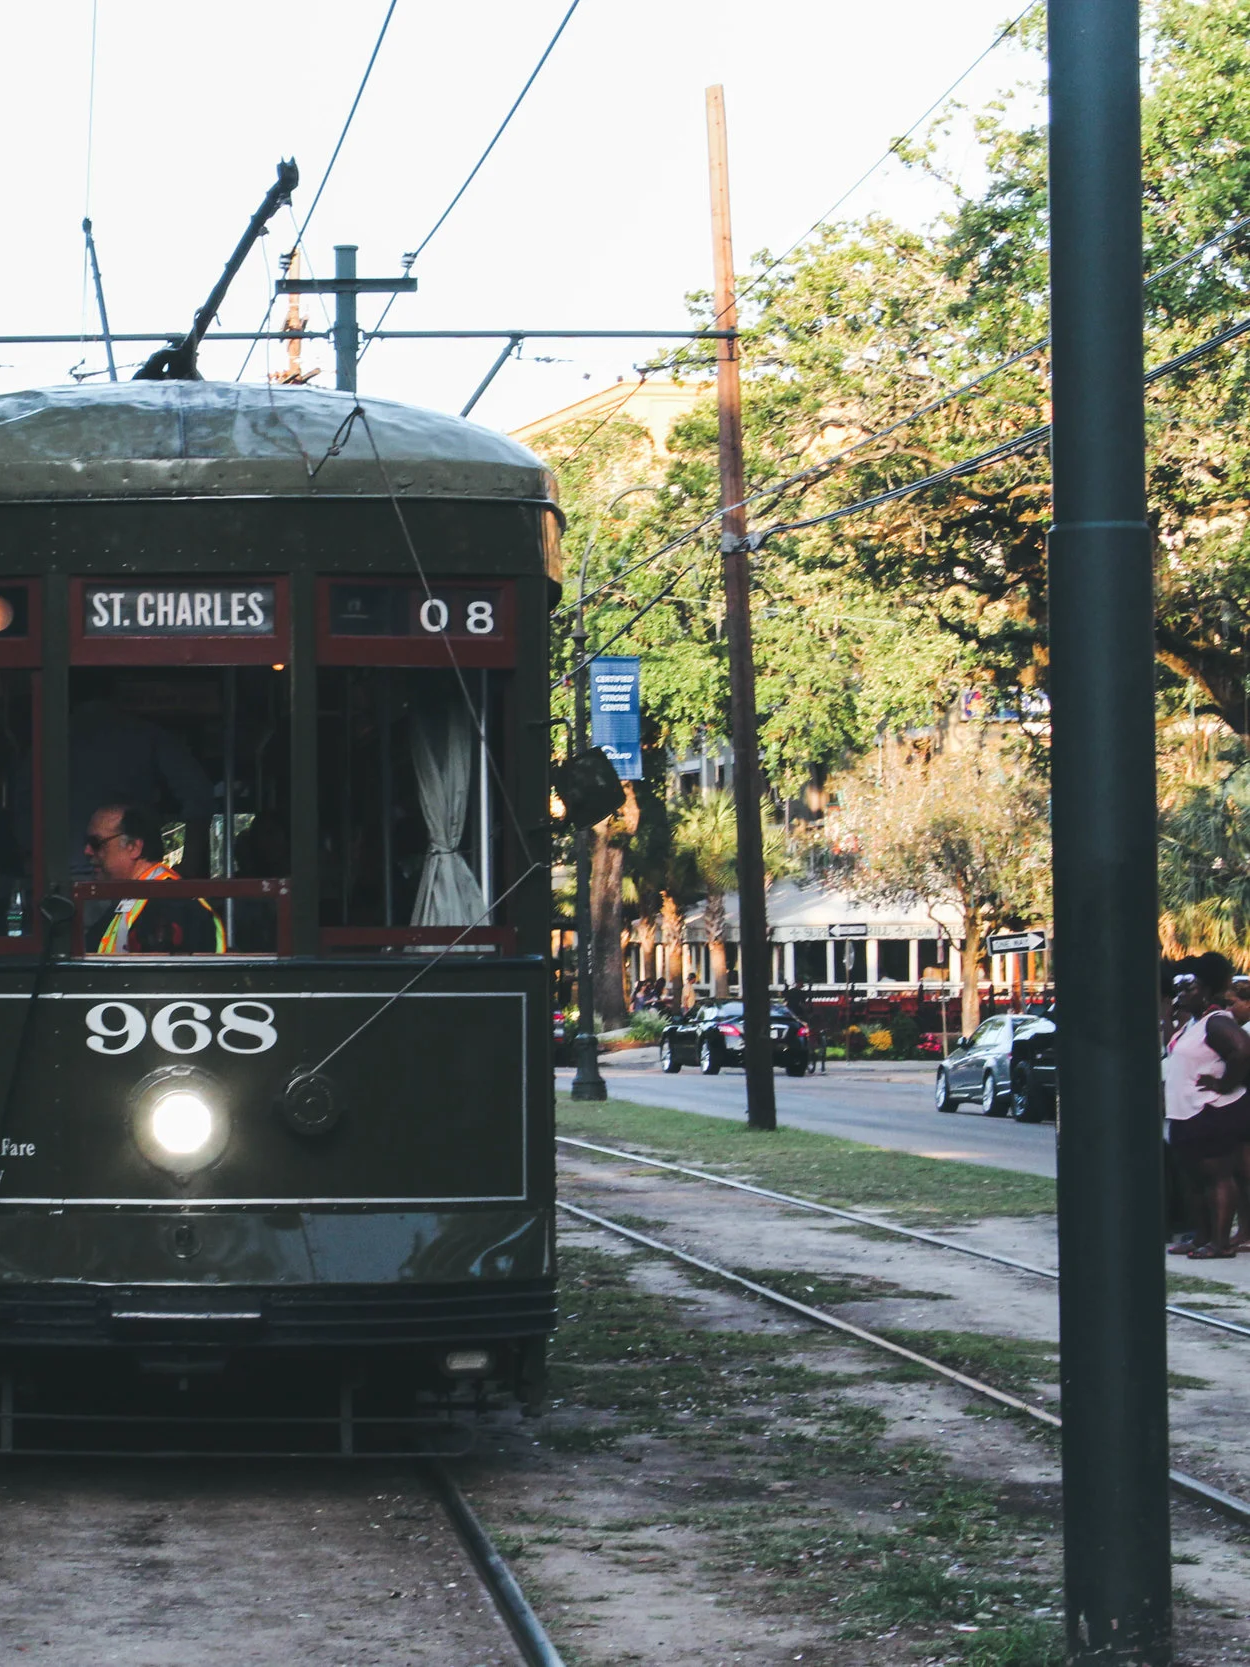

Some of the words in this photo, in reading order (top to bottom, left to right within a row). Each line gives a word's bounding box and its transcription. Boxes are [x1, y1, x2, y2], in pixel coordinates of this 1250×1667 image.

[91, 592, 130, 627] ST.
[136, 591, 265, 627] CHARLES
[84, 1001, 278, 1055] 968
[0, 1137, 36, 1156] Fare
